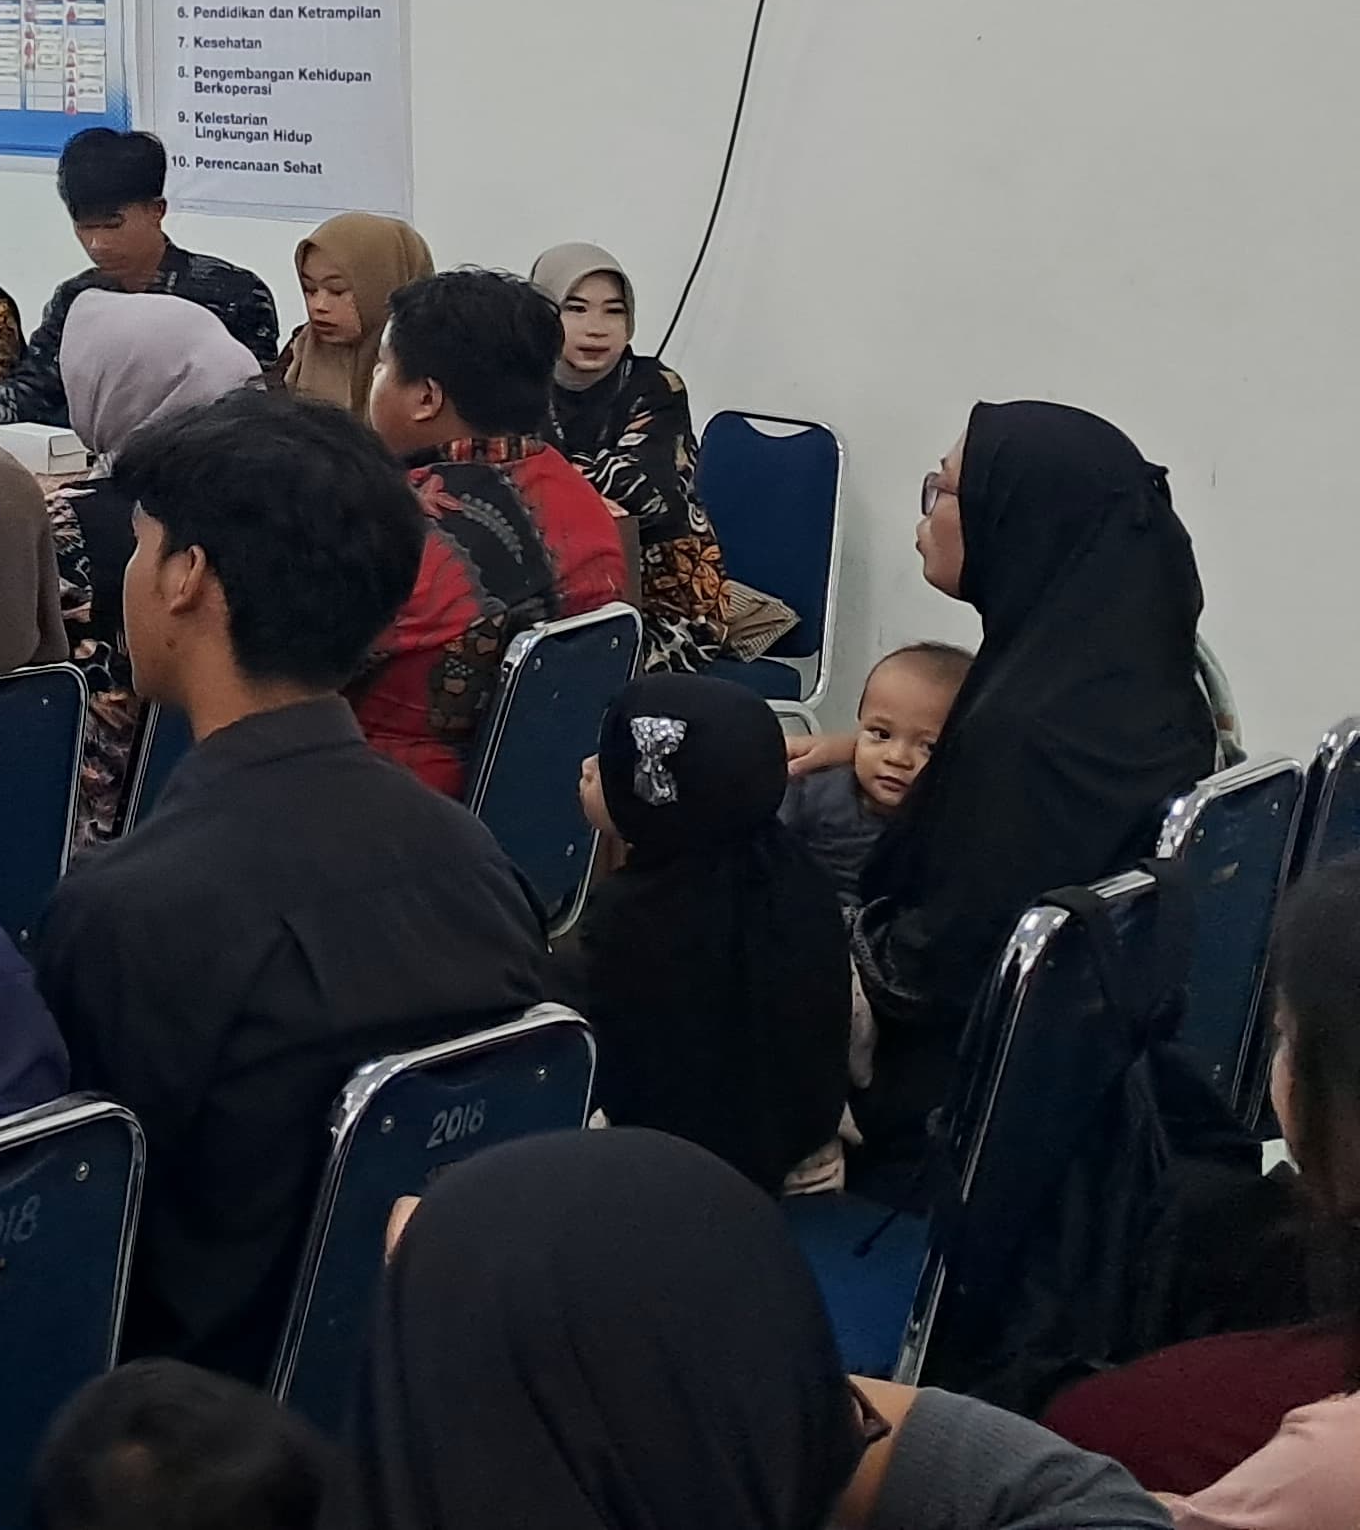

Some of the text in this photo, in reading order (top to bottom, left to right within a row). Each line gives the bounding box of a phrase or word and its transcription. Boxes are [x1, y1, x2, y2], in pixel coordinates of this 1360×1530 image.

[177, 6, 381, 20] 6. Pendidikan dan Ketrampilan
[177, 36, 262, 49] 7. Kesehatan
[194, 66, 294, 82] Pengembangan
[298, 68, 372, 83] Kehidupan
[194, 82, 272, 96] Berkoperasi
[177, 111, 268, 125] 9. Kelestarian
[195, 126, 312, 145] Lingkungan Hidup
[171, 155, 323, 174] 10. Perencanaan Sehat
[425, 1098, 486, 1149] 2018
